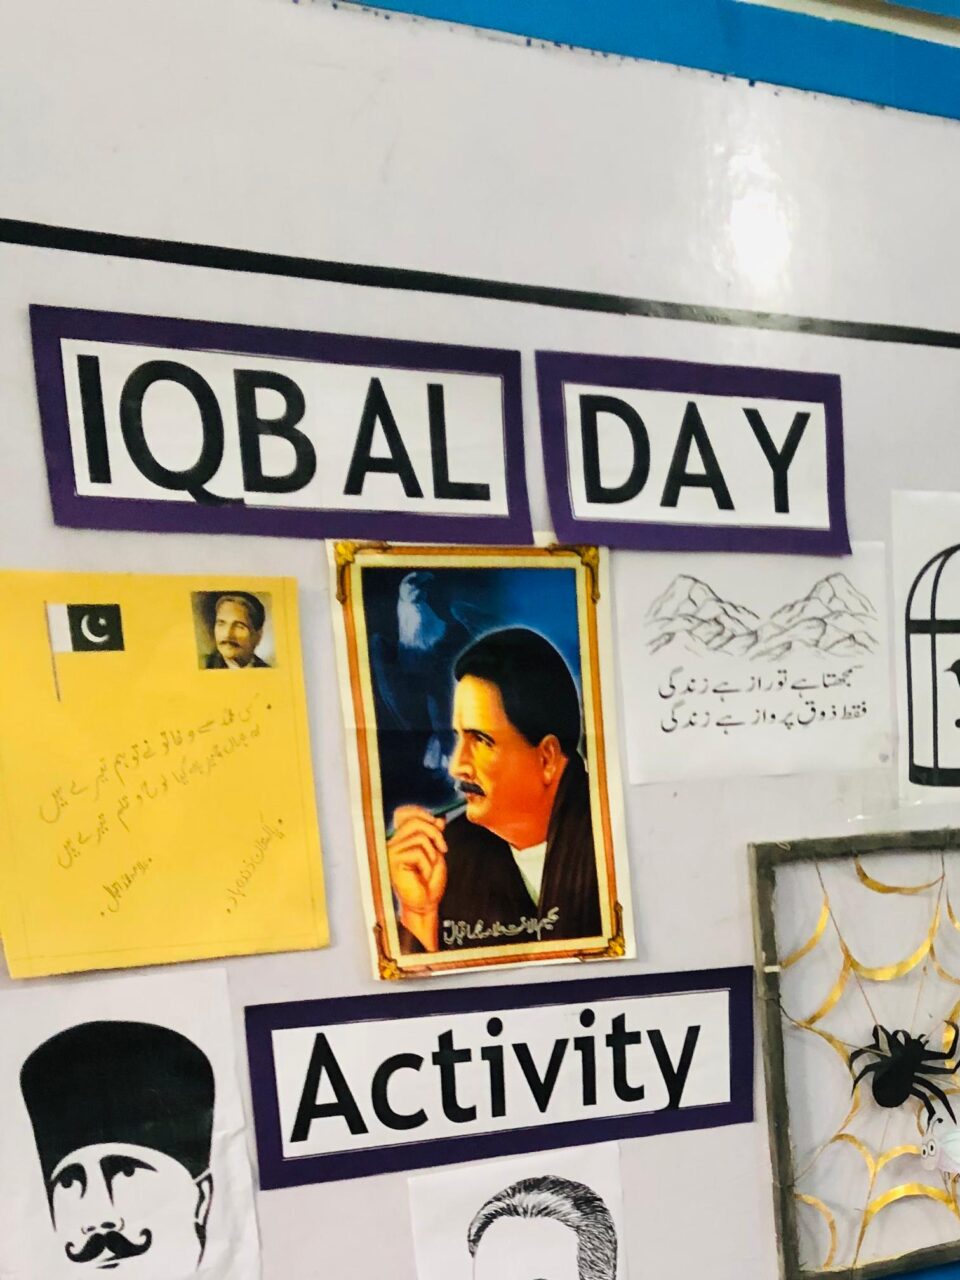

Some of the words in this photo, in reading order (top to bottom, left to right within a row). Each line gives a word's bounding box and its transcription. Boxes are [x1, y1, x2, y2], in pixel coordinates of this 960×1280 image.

[75, 354, 491, 505] IQBAL
[578, 393, 811, 514] DAY
[290, 1008, 701, 1143] Activity
